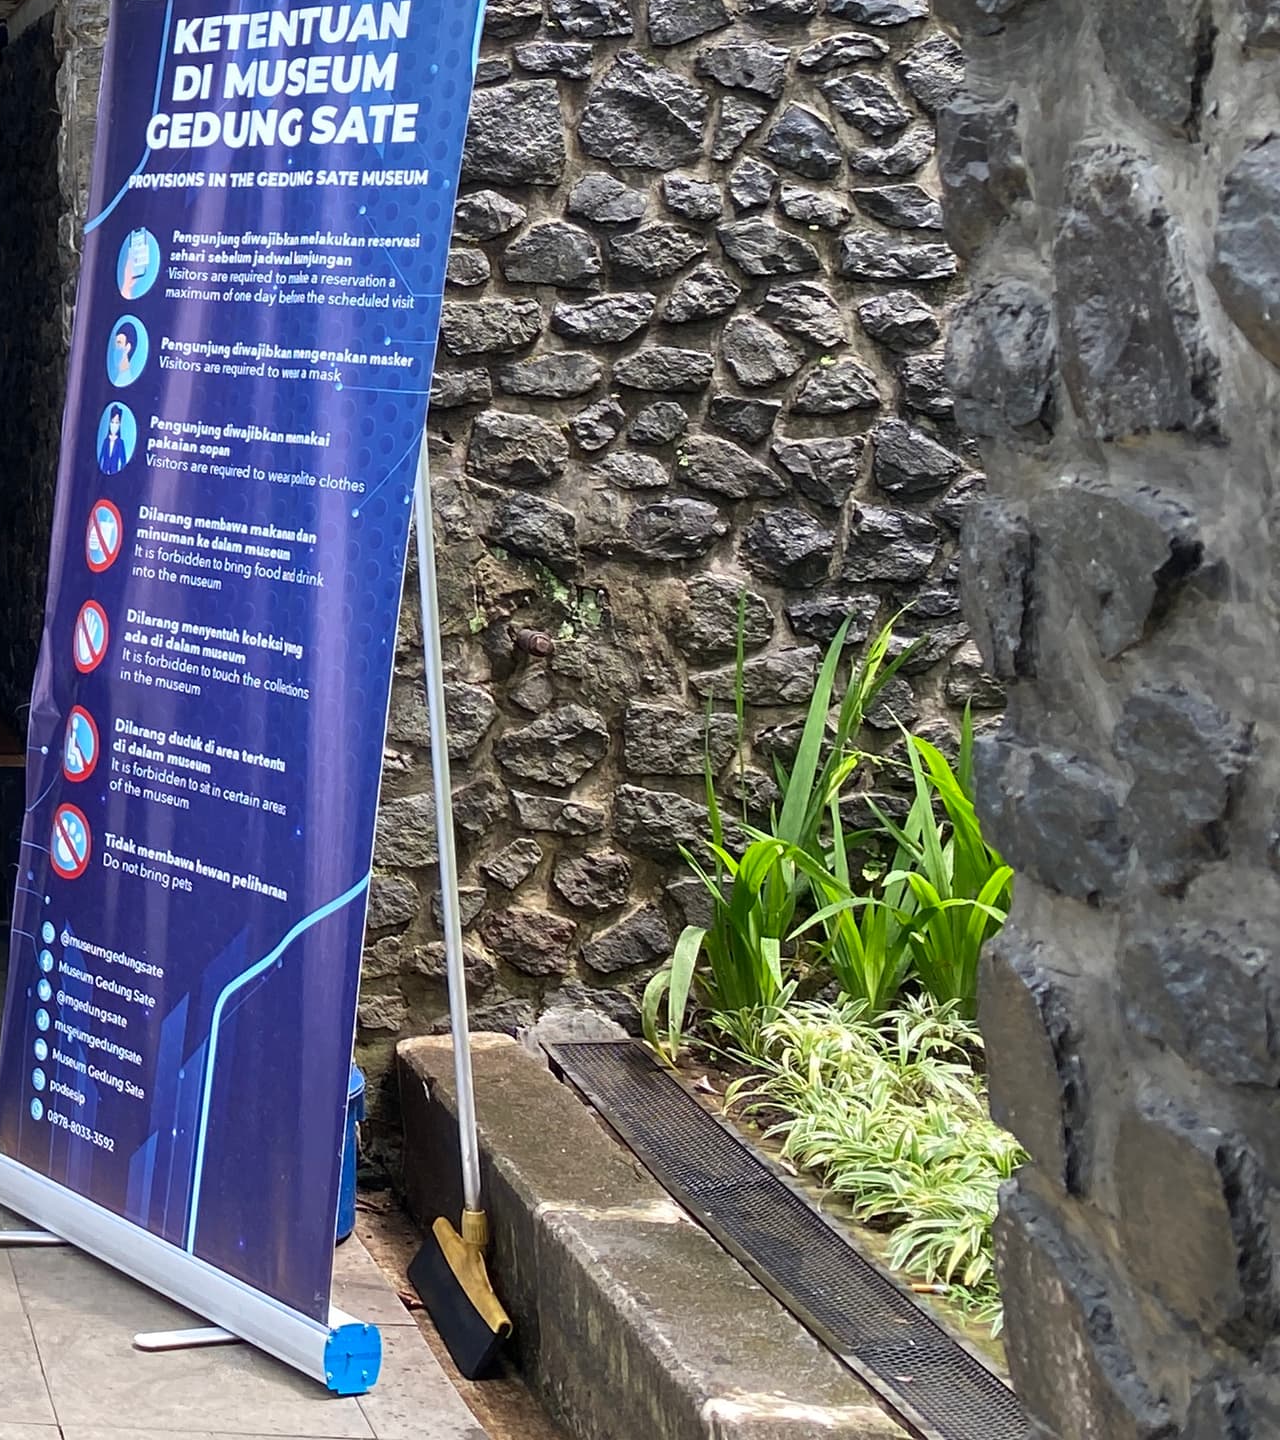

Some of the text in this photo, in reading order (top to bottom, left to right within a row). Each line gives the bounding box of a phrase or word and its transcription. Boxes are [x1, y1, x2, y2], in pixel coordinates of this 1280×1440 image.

[174, 0, 410, 54] KETENTUAN
[172, 53, 398, 101] DI MUSEUM
[146, 103, 419, 151] GEDUNG SATE
[127, 169, 429, 189] PROVISIONS IN THE GEDUNG SATE MUSEUM
[147, 435, 231, 459] pakaian sopan
[150, 415, 222, 440] Pengunjung
[124, 629, 246, 665] ada di dalam museum
[126, 608, 180, 635] Dilarang
[181, 623, 240, 643] menyentuh
[241, 629, 284, 651] koleksi
[120, 669, 201, 696] in the museum
[112, 738, 211, 774] di dalam museum
[114, 718, 166, 746] Dilarang
[168, 731, 203, 752] duduk
[203, 739, 216, 754] di
[215, 745, 240, 761] area
[103, 852, 193, 892] Do not bring pets
[104, 832, 137, 854] Tidak
[137, 846, 195, 872] membawa
[195, 858, 231, 883] hewan
[60, 930, 164, 978] @museumgedungsate
[58, 960, 156, 1008] Museum Gedung Sate
[56, 990, 128, 1028] @mgedungsate
[52, 1047, 145, 1099] Museum Gedung Sate
